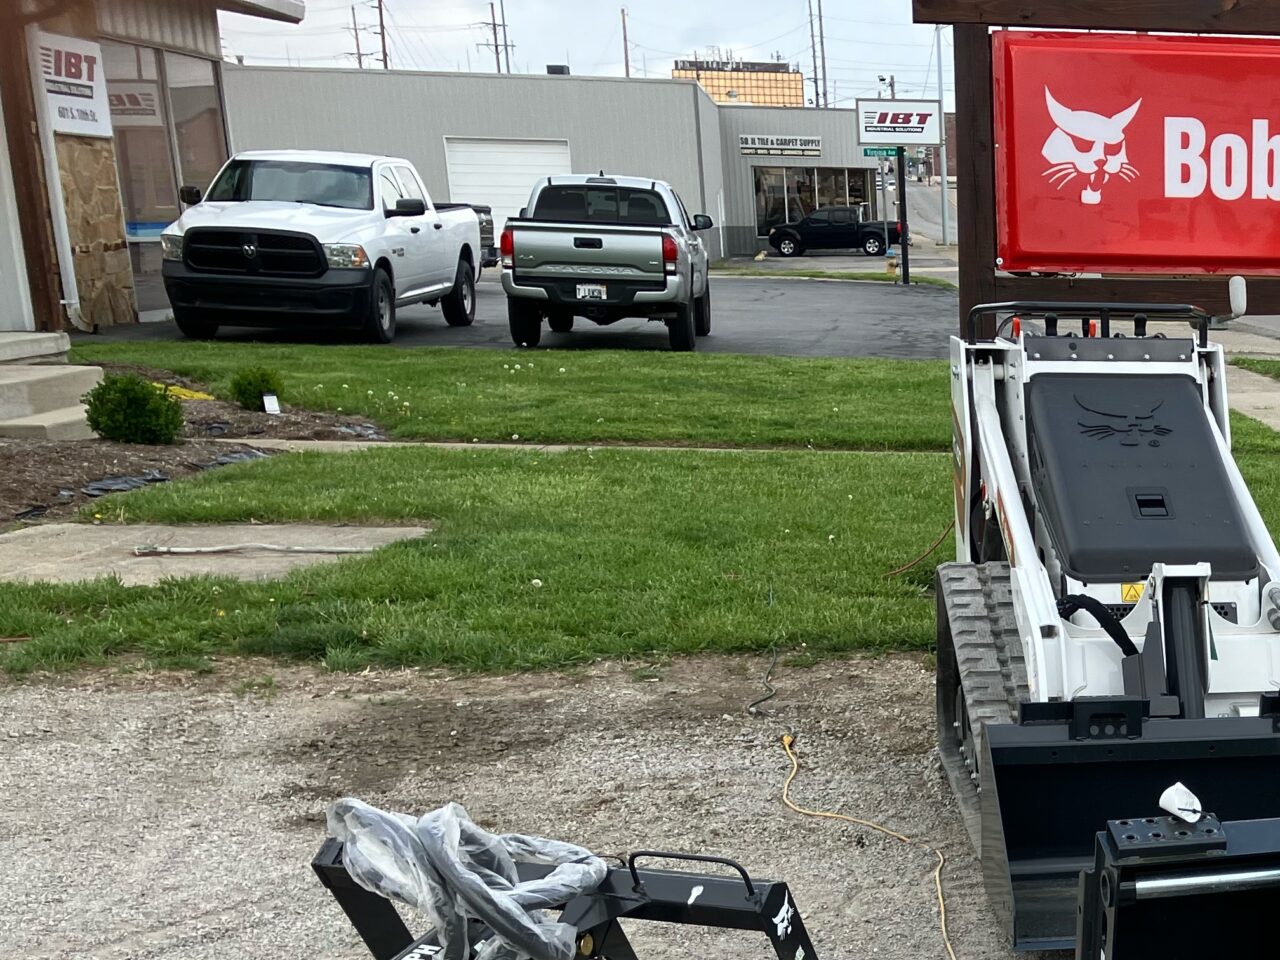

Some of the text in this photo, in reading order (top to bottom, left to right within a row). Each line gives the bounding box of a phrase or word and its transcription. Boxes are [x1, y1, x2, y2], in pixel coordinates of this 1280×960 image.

[54, 49, 96, 82] IBT
[877, 112, 932, 124] IBT
[776, 138, 798, 146] CARPET
[799, 139, 820, 147] SUPPLY
[547, 265, 633, 274] TACOMA
